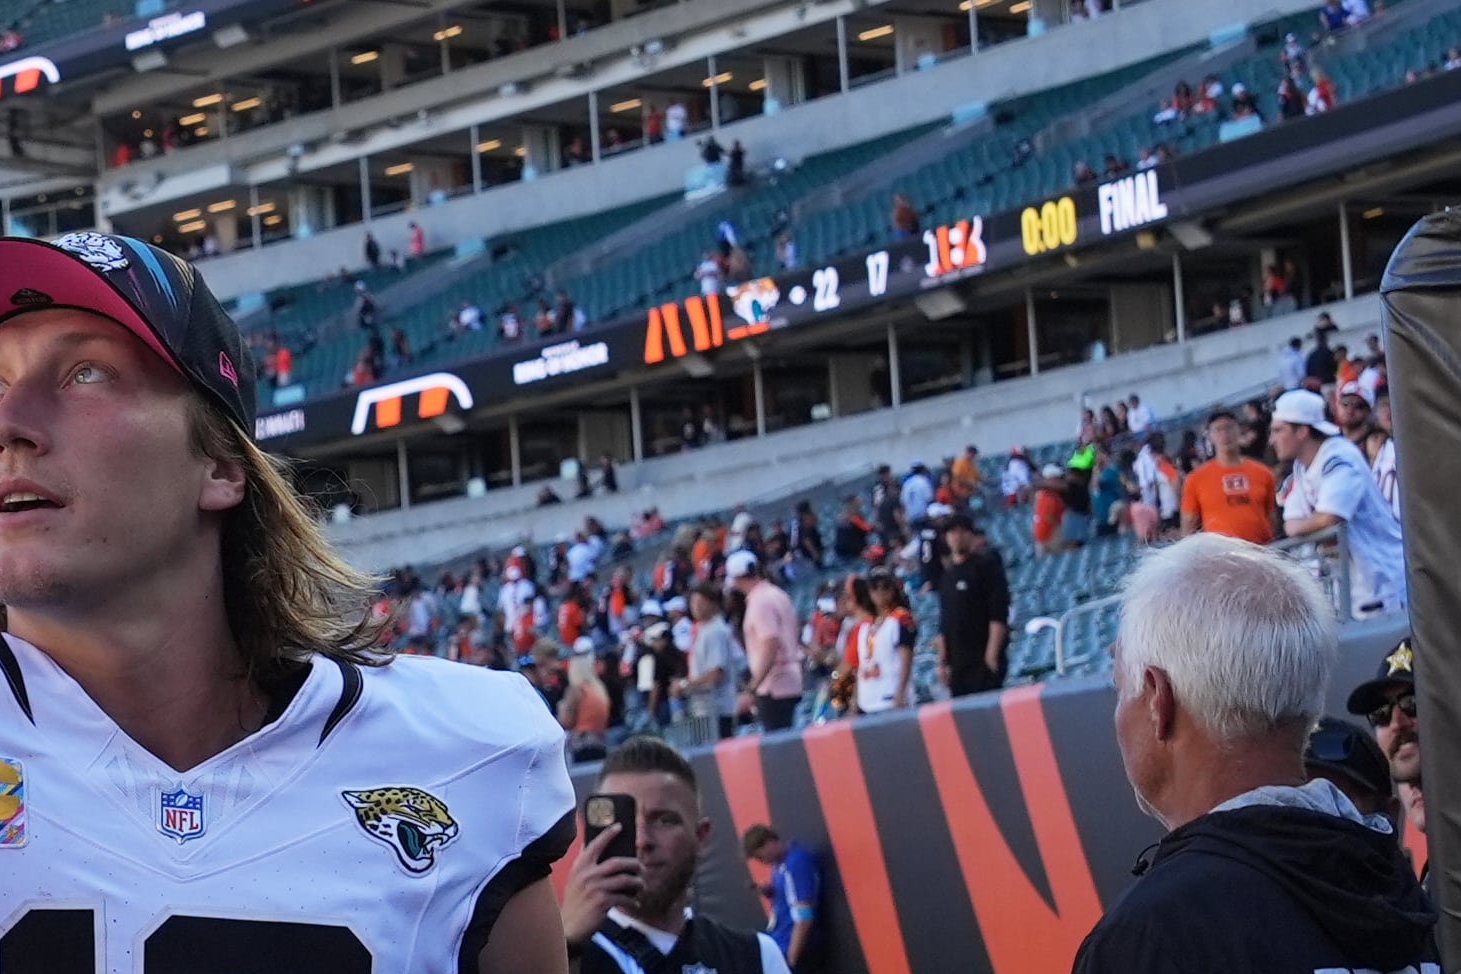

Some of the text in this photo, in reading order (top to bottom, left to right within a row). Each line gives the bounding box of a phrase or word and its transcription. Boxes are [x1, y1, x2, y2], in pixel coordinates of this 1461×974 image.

[1098, 169, 1168, 235] FINAL
[1021, 196, 1077, 255] 0:00
[813, 267, 840, 311] 22
[866, 250, 889, 296] 17
[164, 808, 200, 832] NFL
